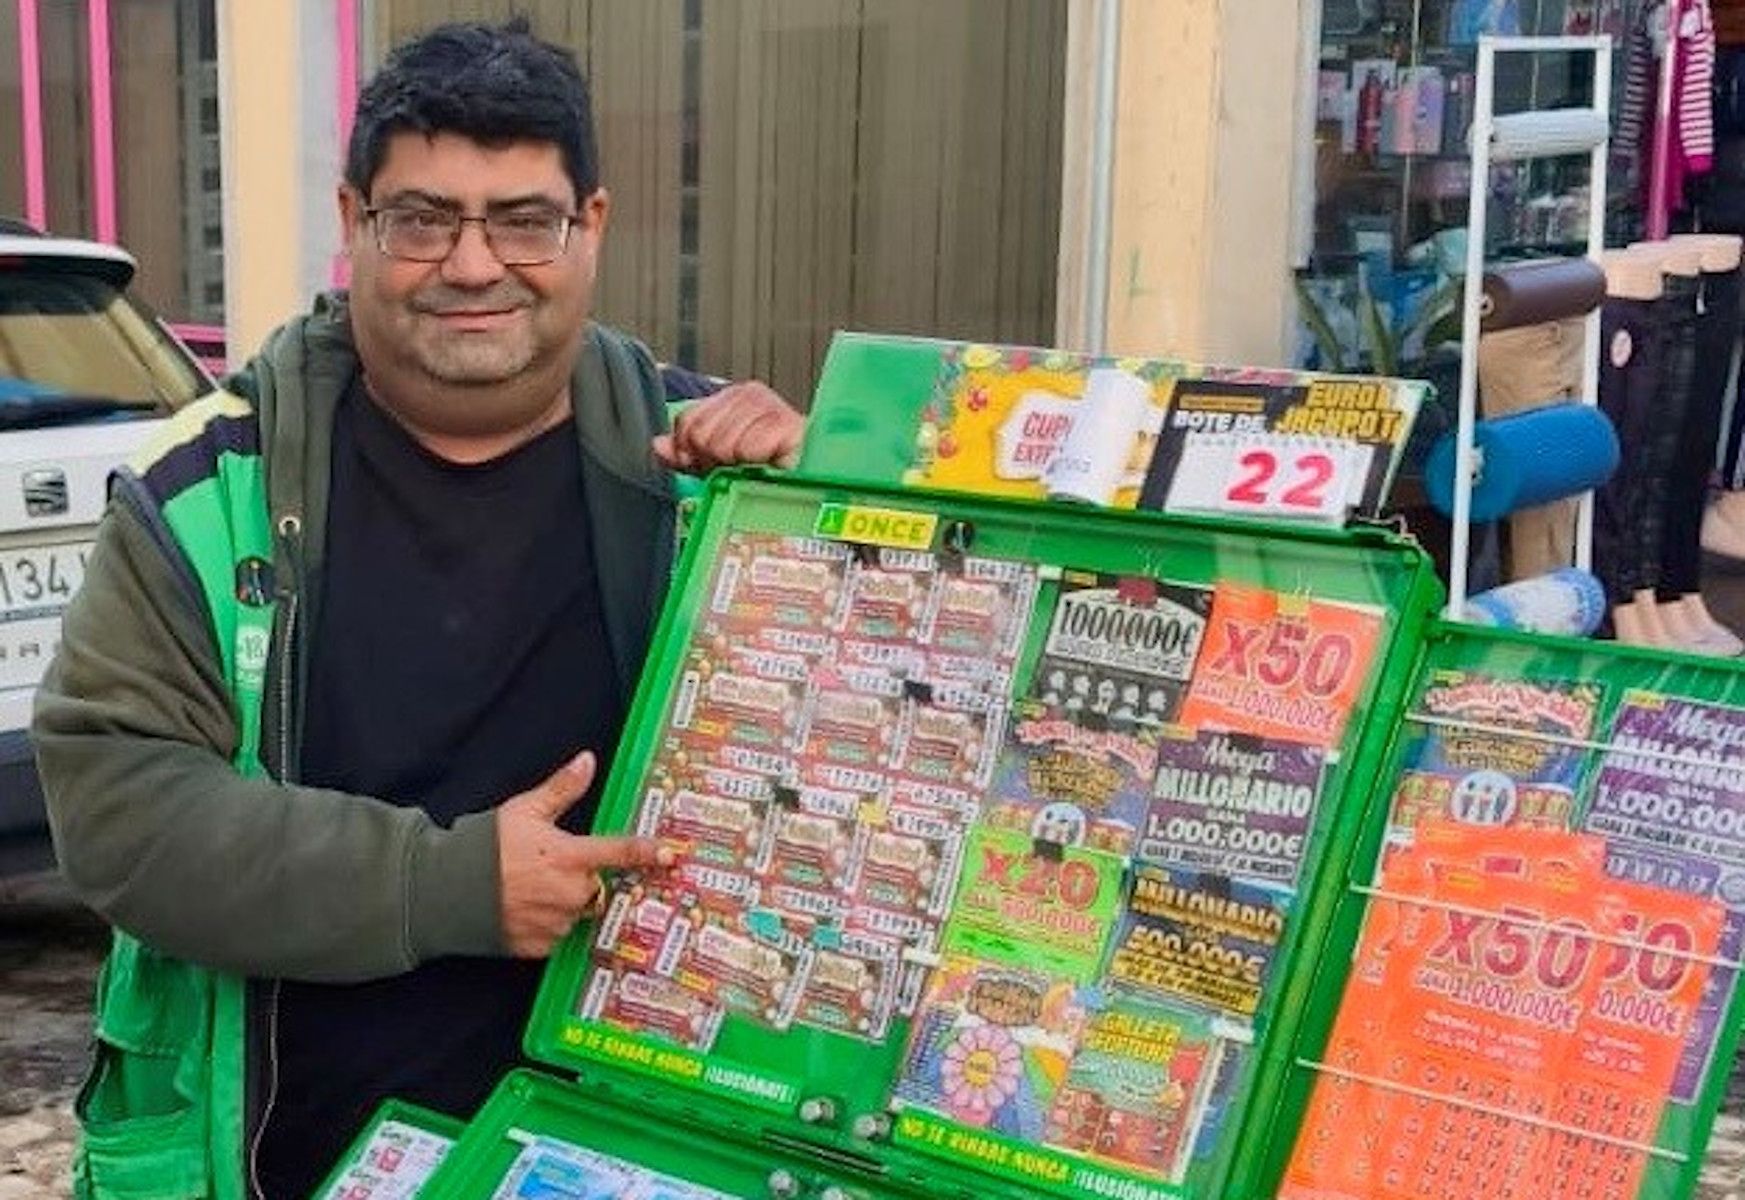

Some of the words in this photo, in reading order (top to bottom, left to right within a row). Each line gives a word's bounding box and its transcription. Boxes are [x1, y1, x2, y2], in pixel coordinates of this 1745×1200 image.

[1023, 410, 1071, 439] CUP
[1173, 409, 1231, 431] BOTE
[1275, 405, 1403, 442] JACKPOT
[1227, 451, 1335, 508] 22
[850, 512, 926, 541] ONCE
[1202, 736, 1276, 776] Mega
[1154, 766, 1313, 819] MILLONARIO
[1147, 813, 1304, 858] 1.000.000€
[1131, 876, 1284, 946] MILLONARIO
[1451, 976, 1578, 1027] 1.000.000€
